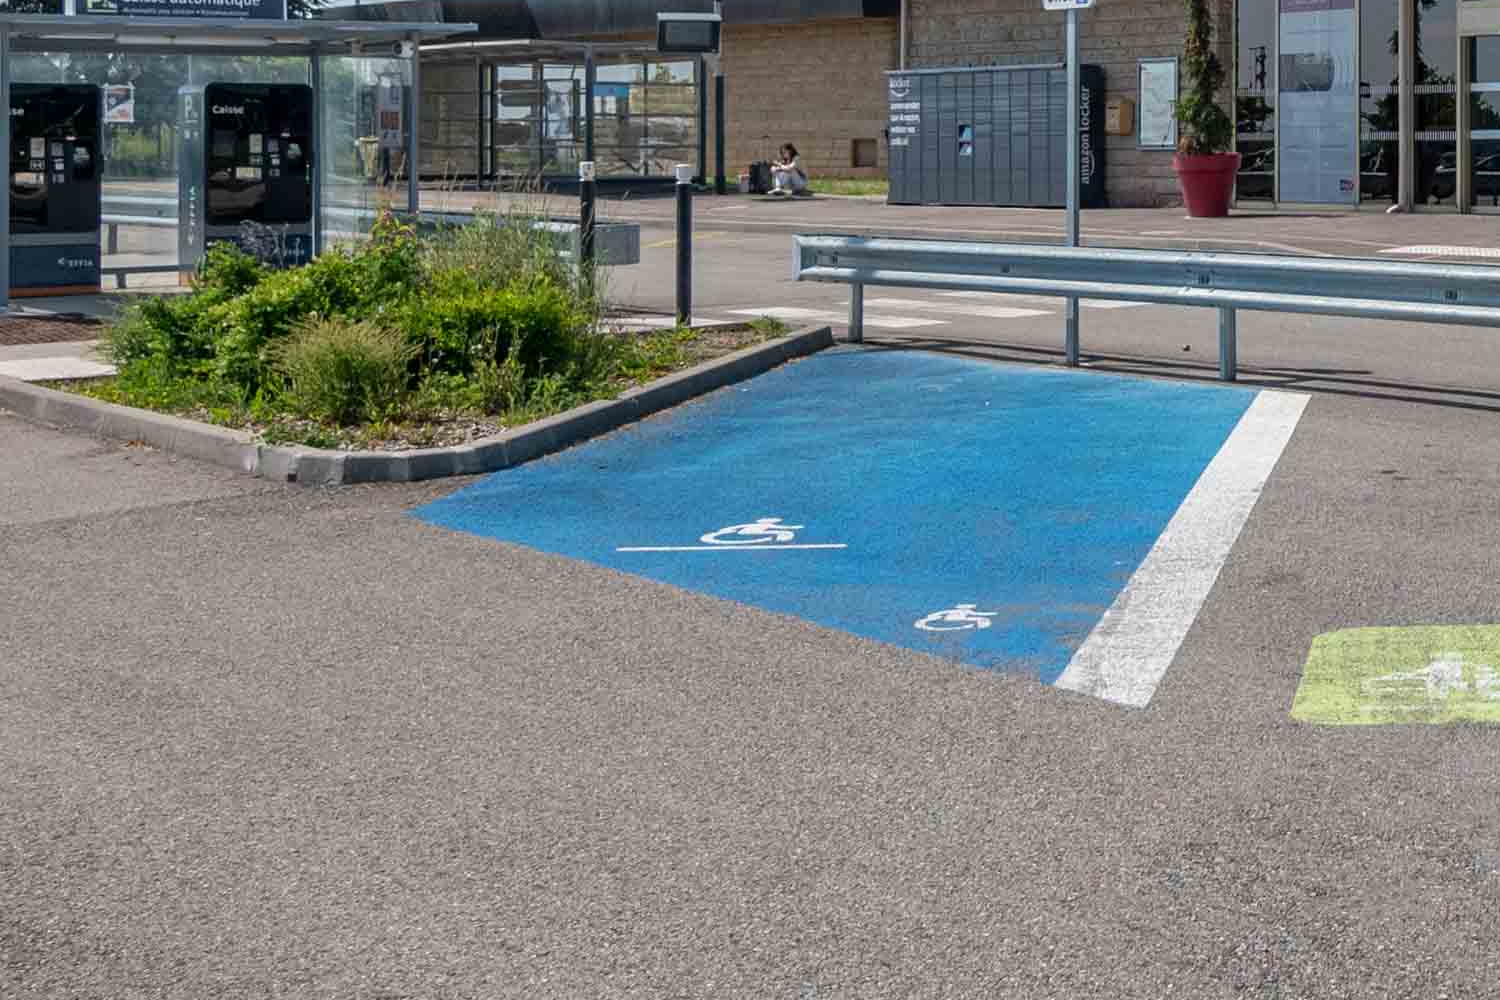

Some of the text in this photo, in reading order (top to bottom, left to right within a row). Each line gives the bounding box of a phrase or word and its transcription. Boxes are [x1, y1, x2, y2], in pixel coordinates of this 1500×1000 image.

[212, 104, 245, 115] Caisse
[1079, 85, 1090, 185] amazon locker
